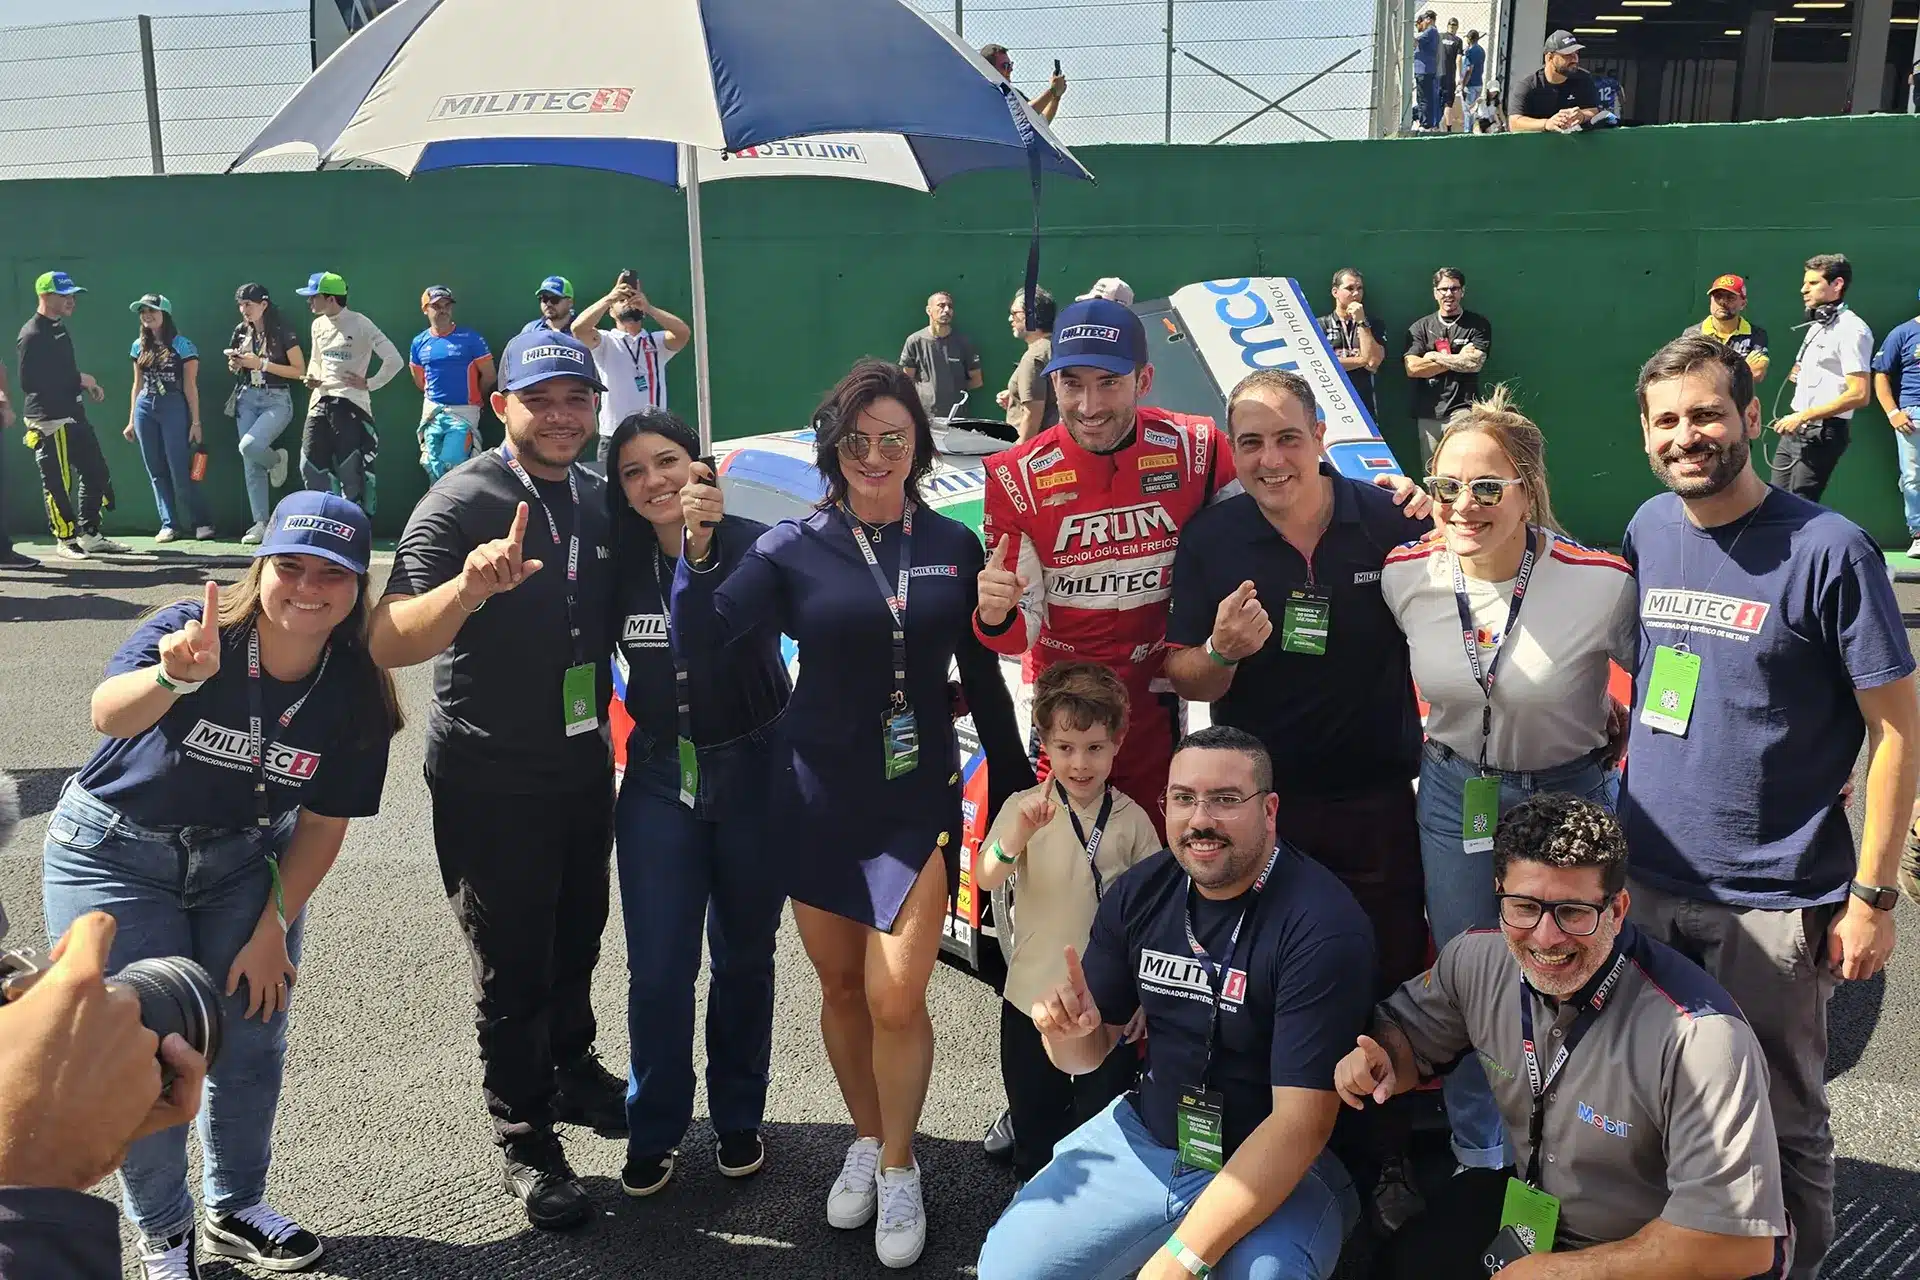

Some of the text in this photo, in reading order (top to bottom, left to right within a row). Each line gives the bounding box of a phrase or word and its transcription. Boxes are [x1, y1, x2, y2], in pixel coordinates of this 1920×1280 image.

[1598, 87, 1612, 101] 12
[1267, 285, 1303, 333] melhor
[1298, 337, 1316, 355] do
[1310, 360, 1347, 411] certeza
[996, 465, 1027, 513] sparco
[1053, 502, 1179, 553] FRUM
[912, 566, 957, 576] MILITEC1
[1053, 537, 1179, 565] TECNOLOGIA EM FREIOS
[1514, 552, 1533, 597] MILITEC1
[1648, 595, 1757, 627] MILITEC1
[251, 718, 260, 764] MILITEC1
[1141, 983, 1189, 998] CONDICIONADOR
[1591, 956, 1625, 1009] MILITEC1
[1523, 1041, 1541, 1096] MILITEC1
